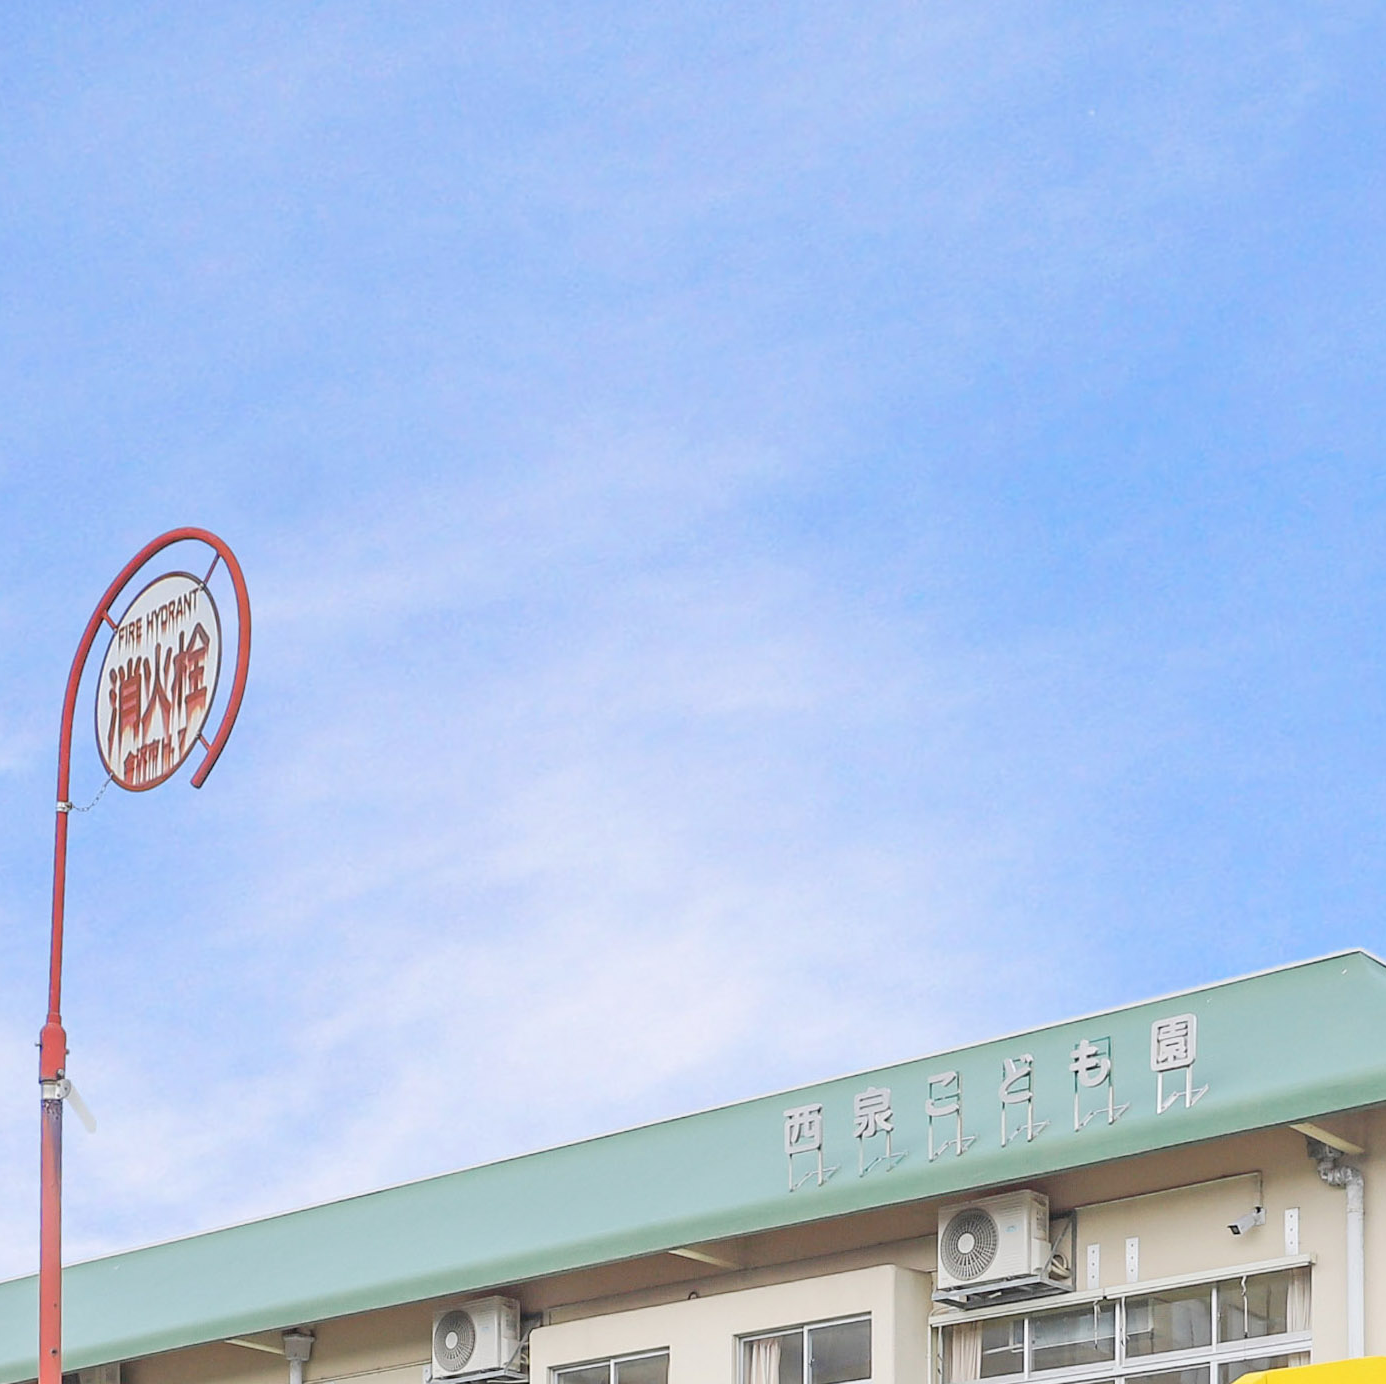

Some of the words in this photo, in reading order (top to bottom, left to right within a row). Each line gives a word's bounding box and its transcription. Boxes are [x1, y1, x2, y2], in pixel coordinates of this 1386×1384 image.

[117, 615, 143, 646] FIRE
[146, 588, 200, 632] HYDRANT
[108, 622, 210, 742] 消火栓
[783, 1013, 1198, 1155] 西泉こども園
